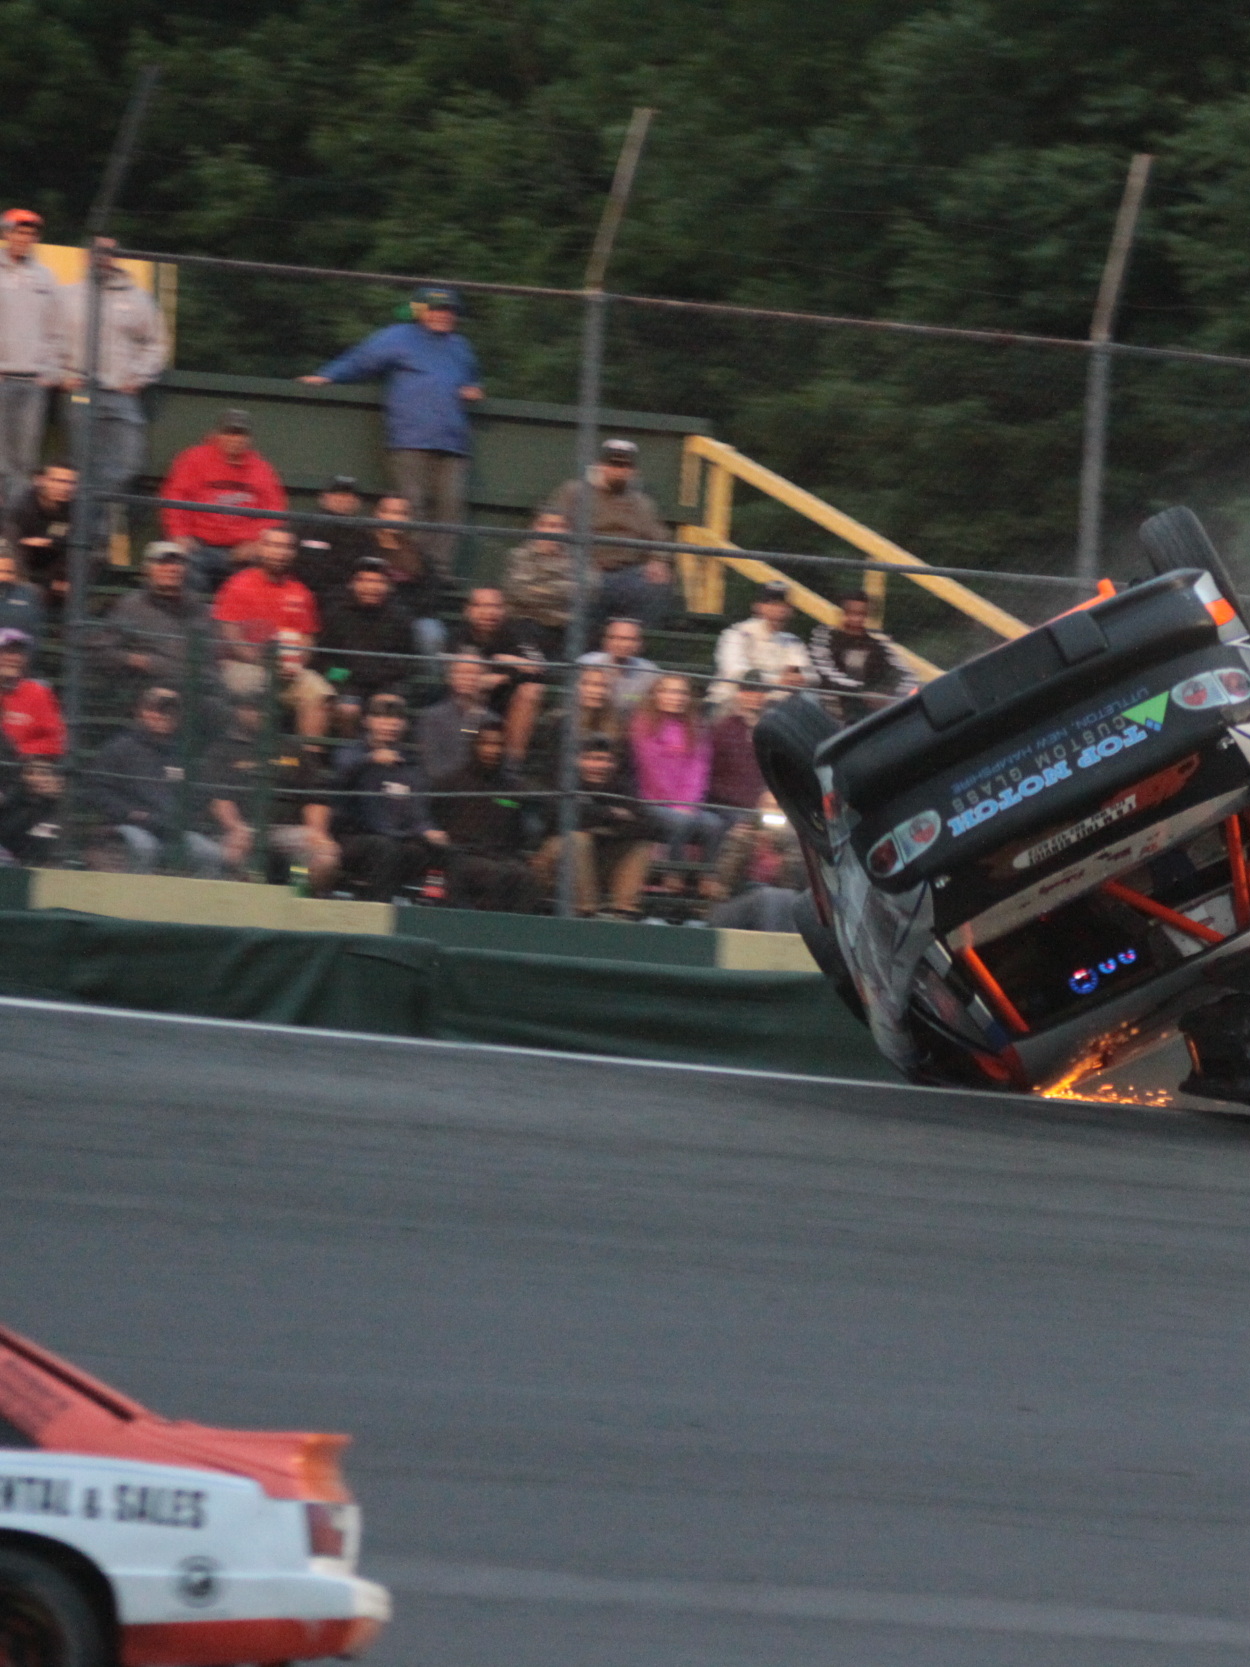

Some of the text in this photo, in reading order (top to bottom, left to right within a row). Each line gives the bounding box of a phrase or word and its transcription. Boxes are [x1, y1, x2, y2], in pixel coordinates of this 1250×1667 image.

[1034, 727, 1067, 751] NEW
[946, 722, 1147, 837] TOP NOTCH
[950, 715, 1126, 812] CUSTOM GLASS
[950, 746, 1033, 794] HAMPSHIRE
[114, 1484, 206, 1529] SALES
